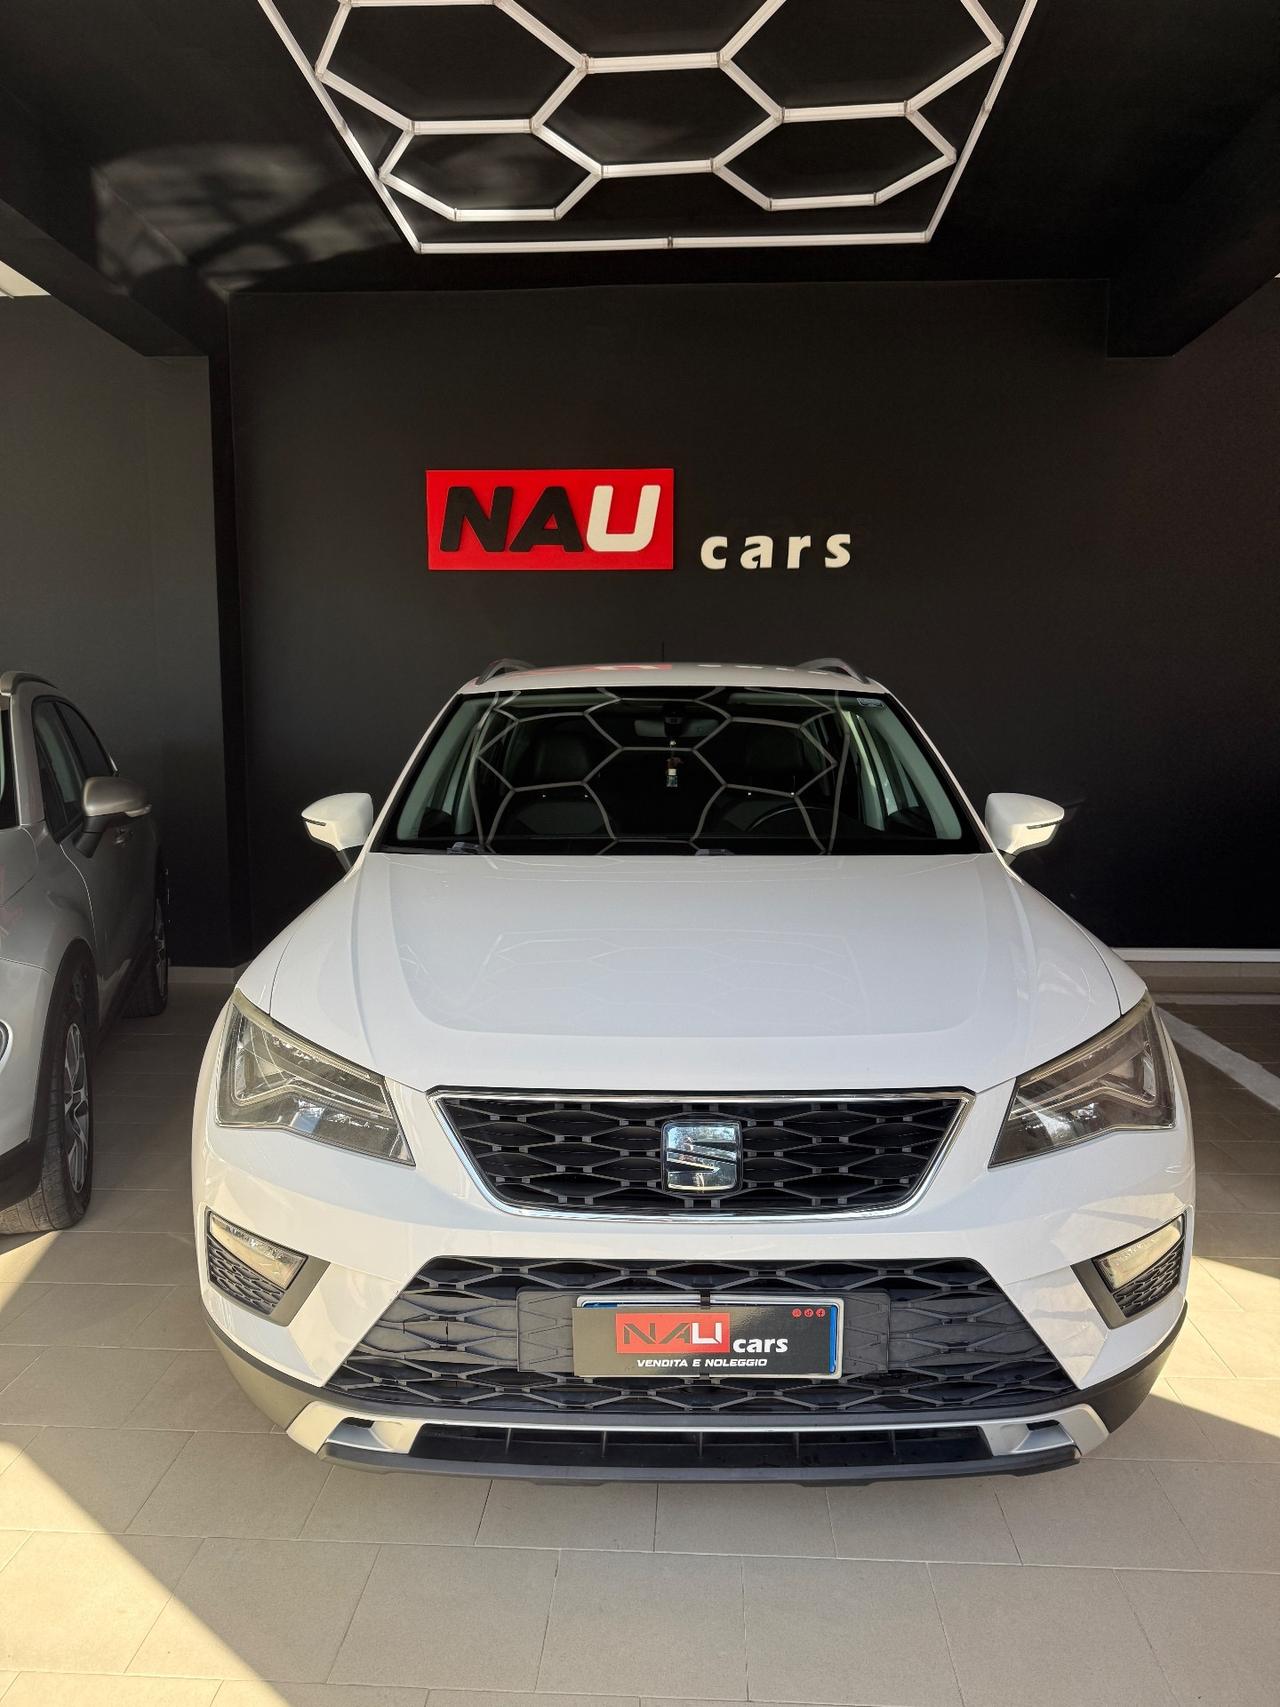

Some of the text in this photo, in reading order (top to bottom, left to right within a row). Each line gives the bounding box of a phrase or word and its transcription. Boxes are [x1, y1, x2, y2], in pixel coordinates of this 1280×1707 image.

[440, 485, 852, 570] NAU cars
[732, 1338, 789, 1353] cars
[636, 1358, 768, 1368] VENDITA E NOLEGGIO
